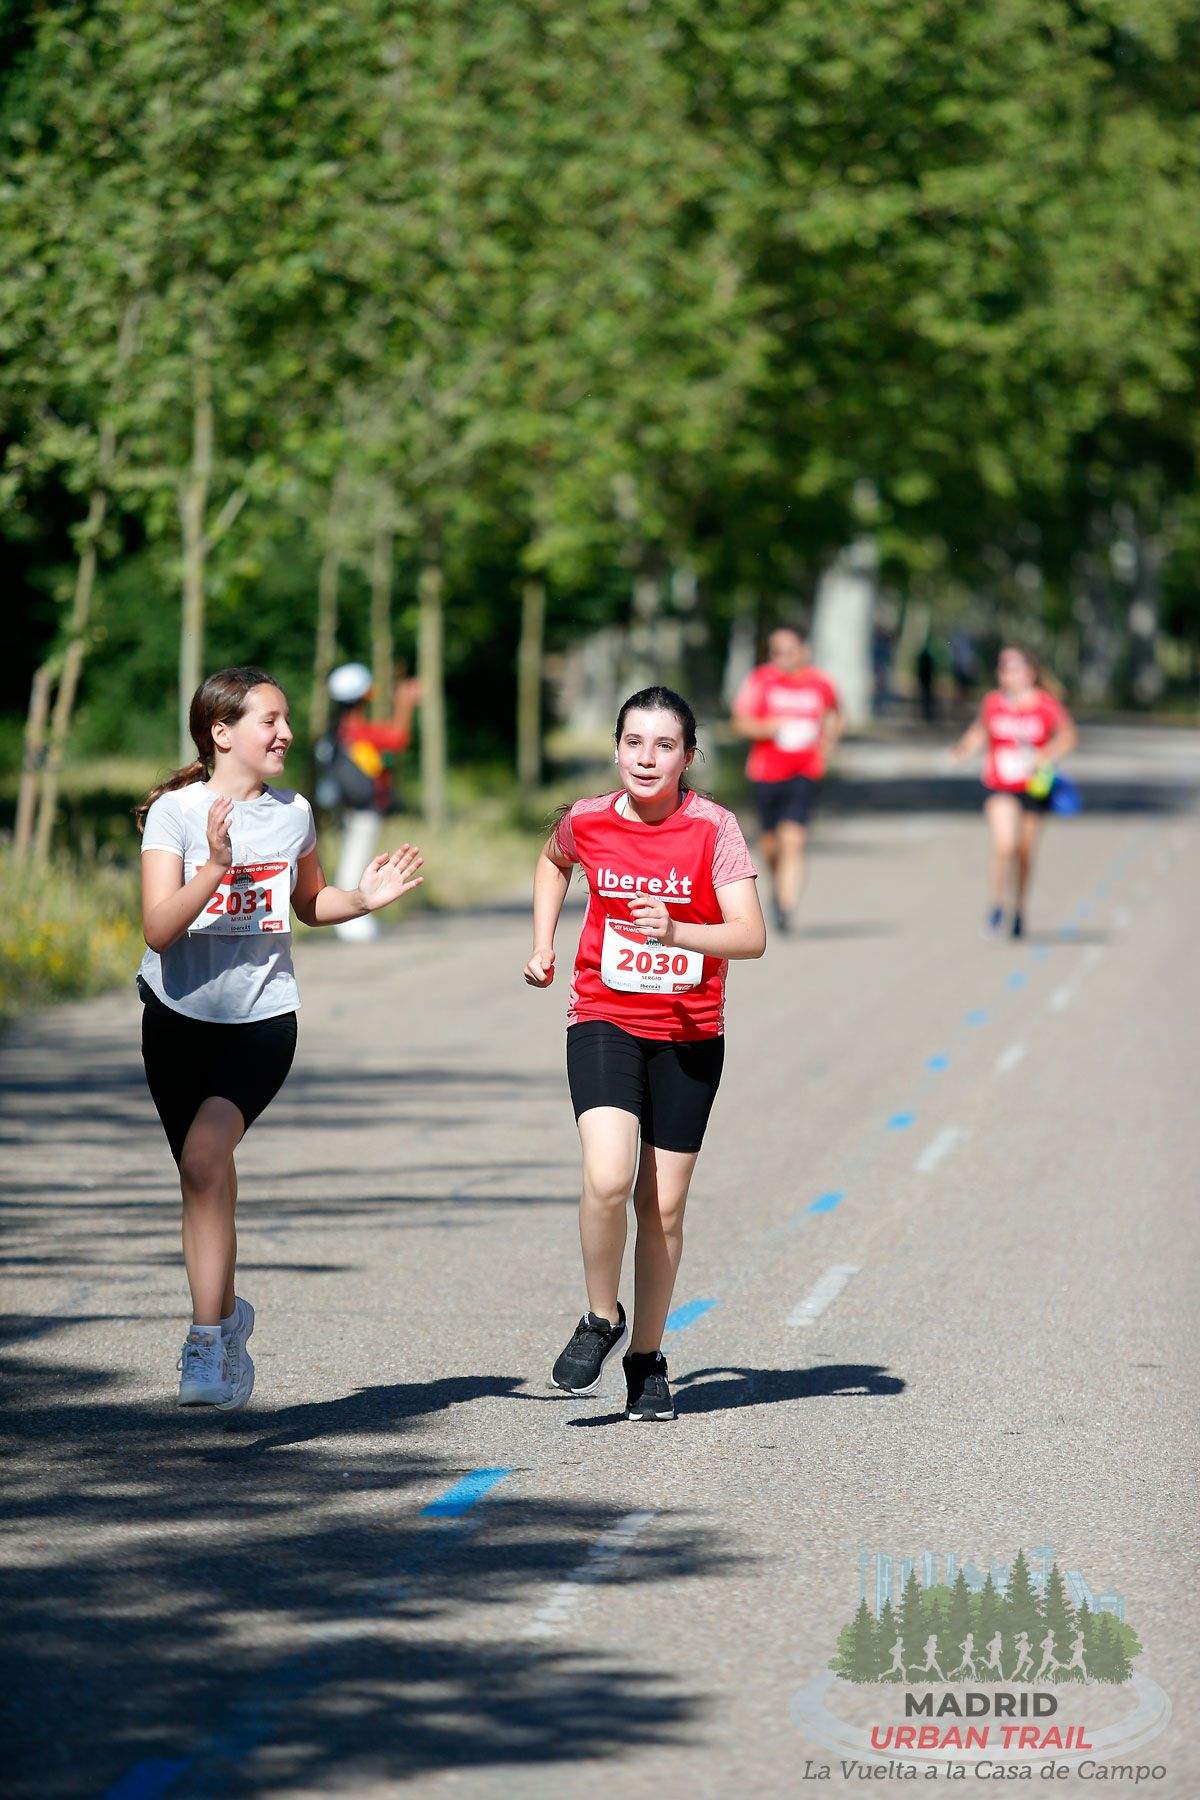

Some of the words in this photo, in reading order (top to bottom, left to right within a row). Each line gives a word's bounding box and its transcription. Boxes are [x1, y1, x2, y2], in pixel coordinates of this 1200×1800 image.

[597, 866, 692, 896] Iberext
[206, 889, 272, 915] 2031
[616, 948, 688, 976] 2030
